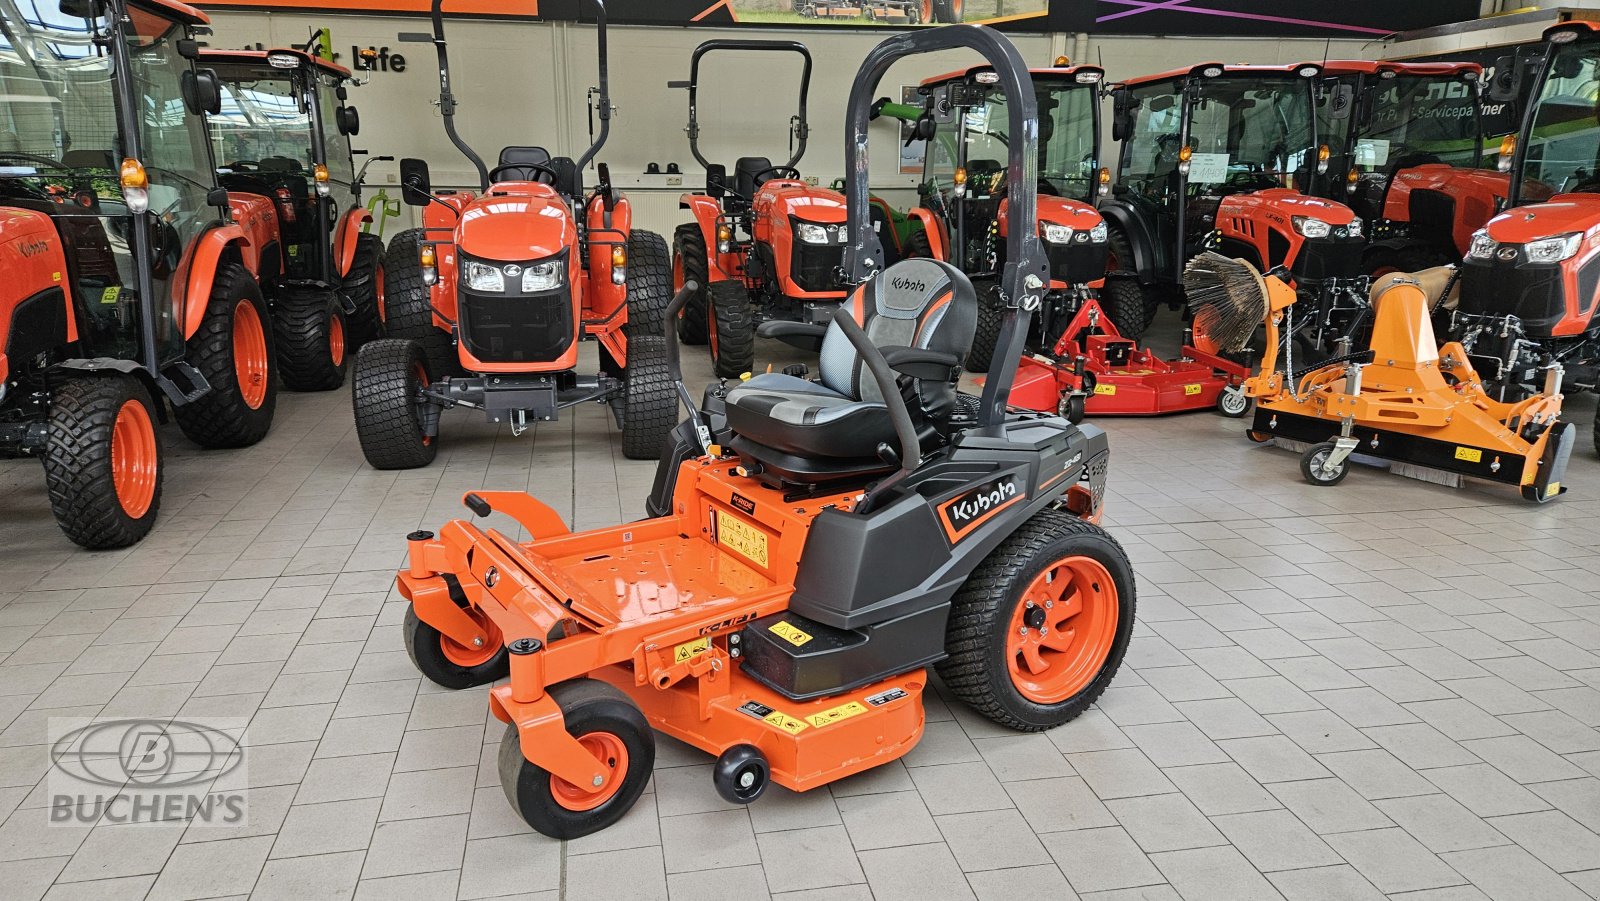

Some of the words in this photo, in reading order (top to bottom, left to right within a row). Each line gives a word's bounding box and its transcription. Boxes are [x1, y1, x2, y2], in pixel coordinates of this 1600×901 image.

[352, 46, 405, 72] Life
[891, 277, 926, 292] Kubota
[952, 481, 1016, 521] Kubota
[700, 611, 757, 636] K-LIFT
